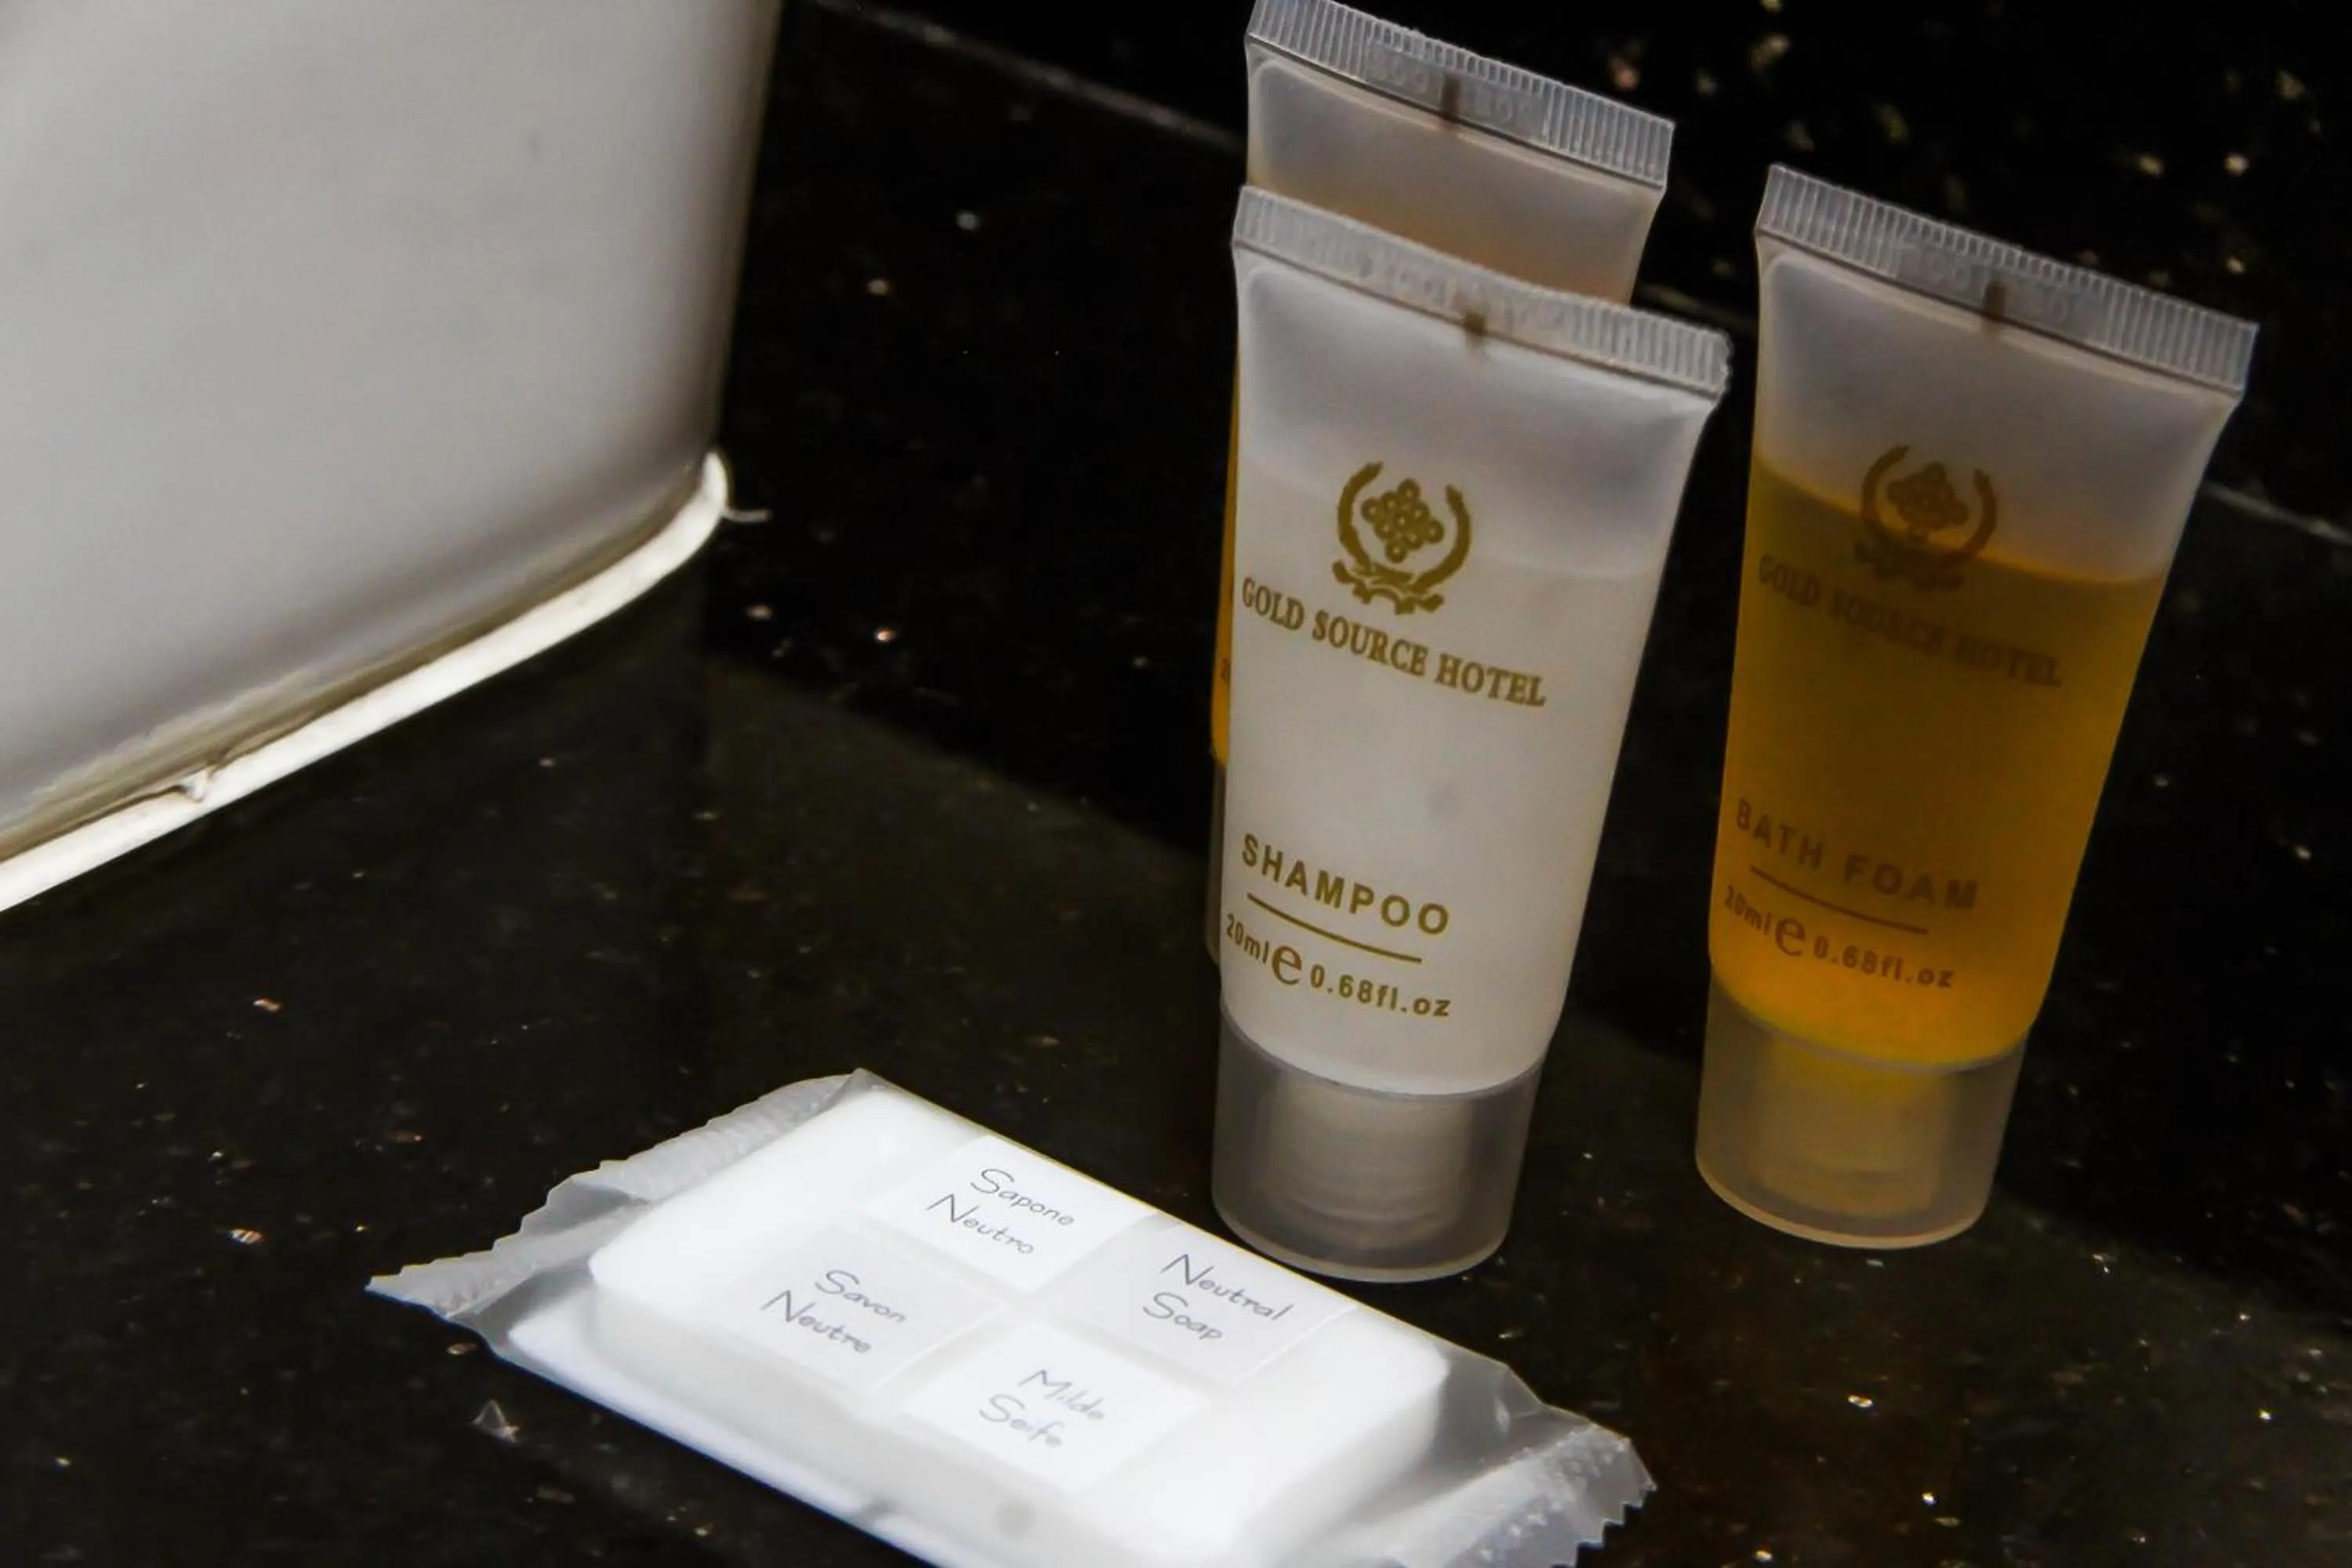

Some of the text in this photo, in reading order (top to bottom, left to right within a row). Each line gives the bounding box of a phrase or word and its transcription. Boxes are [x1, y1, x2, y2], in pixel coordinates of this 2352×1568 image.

[1242, 576, 1547, 707] GOLD SOURCE HOTEL
[1759, 553, 1821, 608] GOLD
[1953, 633, 2063, 688] HOTEL
[1241, 833, 1450, 935] SHAMPOO
[1735, 797, 1980, 910] BATH FOAM
[924, 1192, 1036, 1255] Neutro
[970, 1167, 1075, 1227] Sapone
[814, 1269, 907, 1324] Savon
[1142, 1291, 1224, 1341] Soap
[1160, 1253, 1295, 1322] Neutral
[760, 1289, 873, 1355] Neutre
[978, 1392, 1065, 1449] Seife
[1017, 1369, 1105, 1421] Milde
